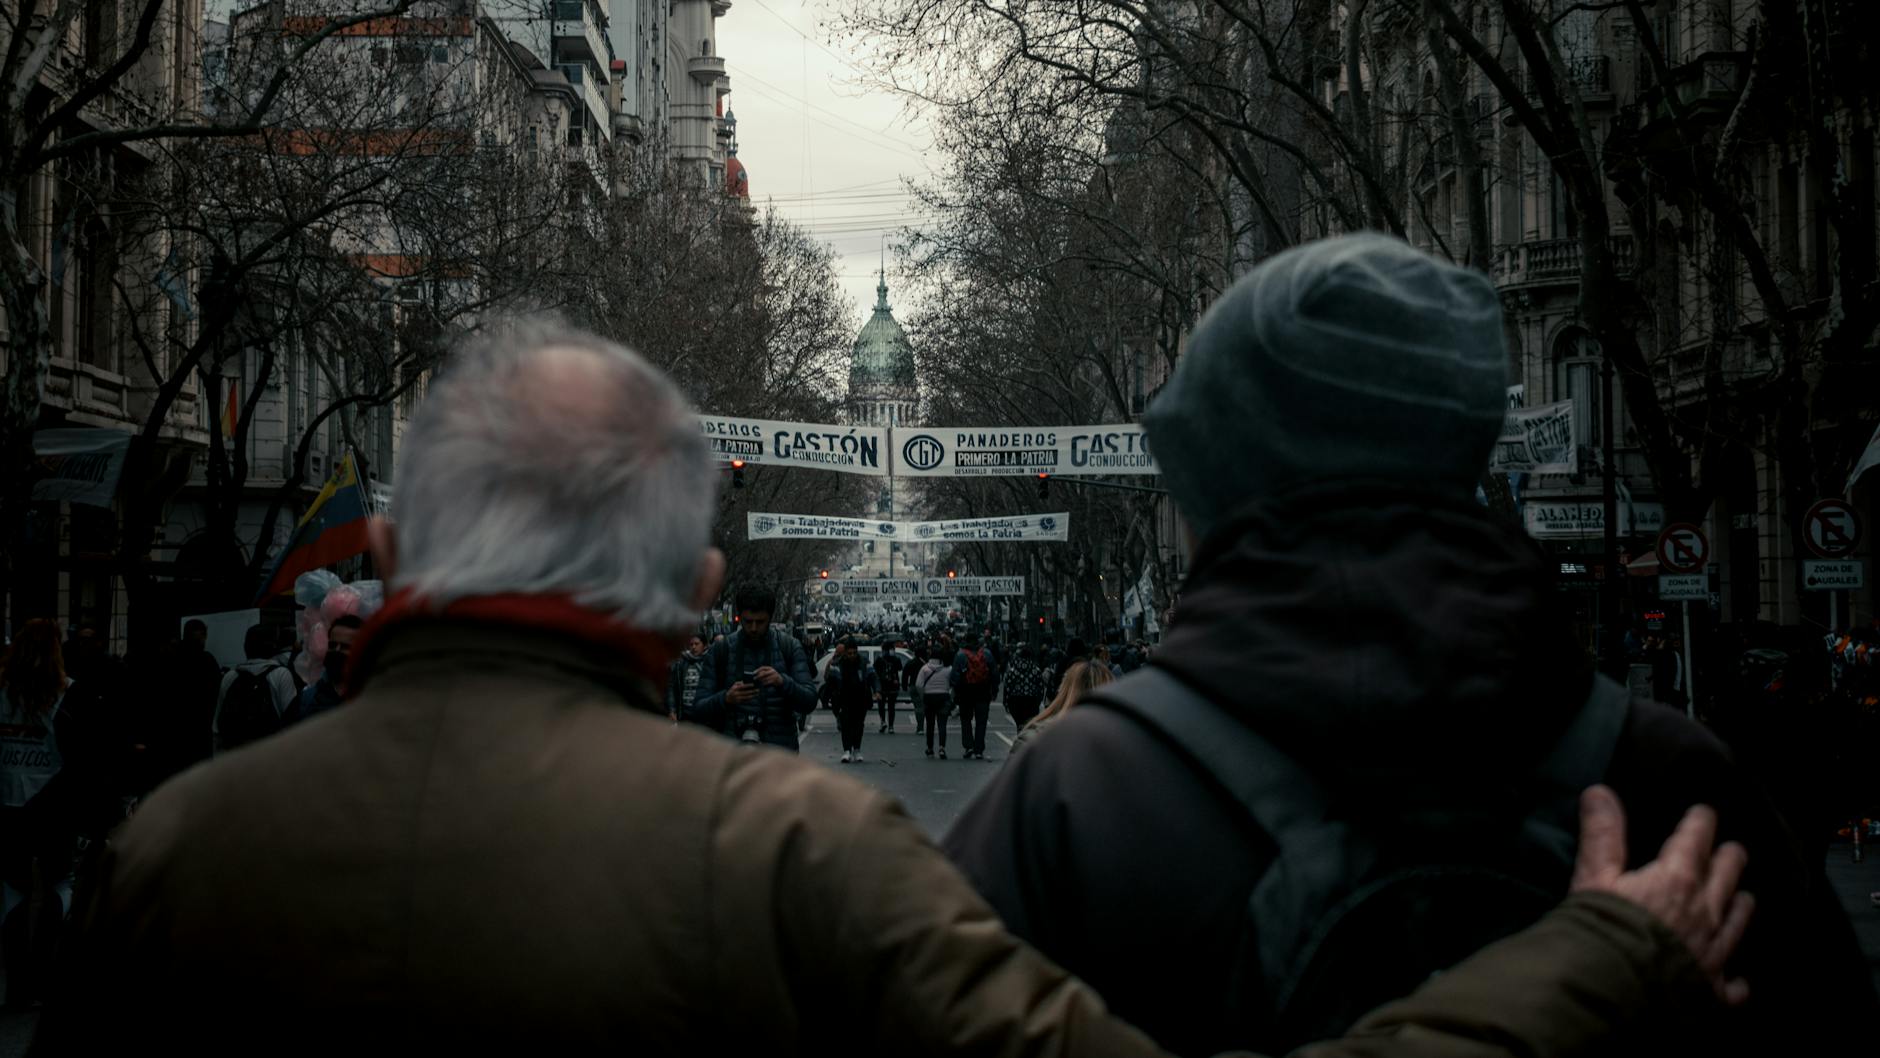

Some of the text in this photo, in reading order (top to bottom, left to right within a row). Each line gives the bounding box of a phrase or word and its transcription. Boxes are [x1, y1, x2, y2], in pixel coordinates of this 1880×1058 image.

[724, 439, 759, 454] PATRIA
[957, 433, 1056, 447] PANADEROS
[774, 429, 878, 467] GASTÓN
[792, 450, 854, 465] CONDUCCIÓN
[957, 451, 1055, 466] PRIMERO LA PATRIA
[782, 527, 813, 535] somos
[830, 527, 859, 536] Patria
[943, 531, 974, 539] somos
[992, 528, 1022, 538] Patria
[1814, 565, 1852, 573] ZONA DE
[882, 579, 919, 594] GASTÓN
[984, 578, 1021, 593] GASTÓN
